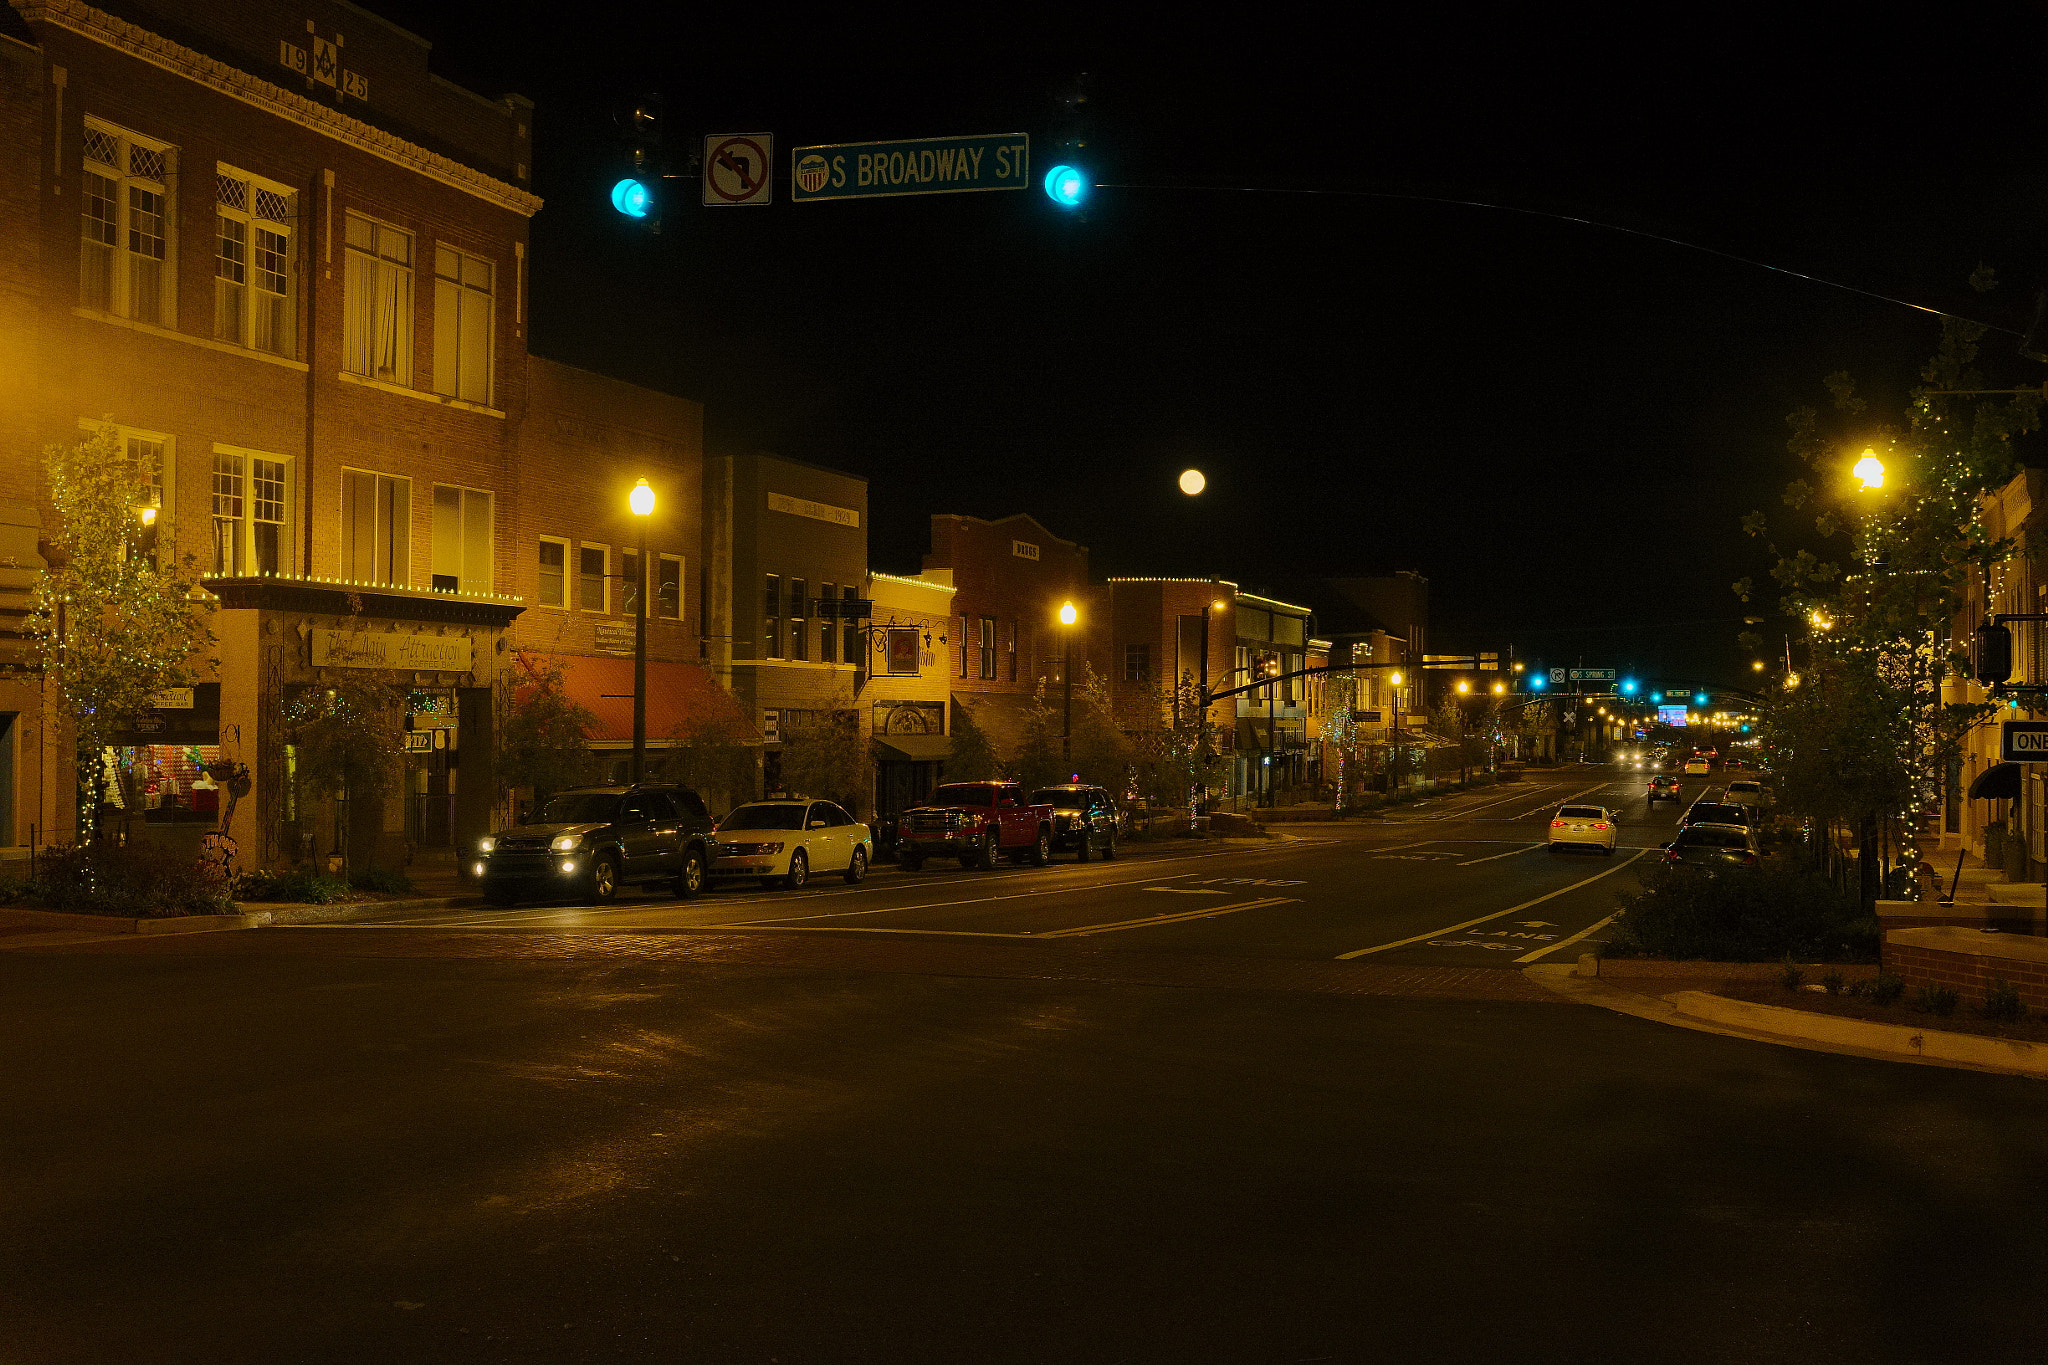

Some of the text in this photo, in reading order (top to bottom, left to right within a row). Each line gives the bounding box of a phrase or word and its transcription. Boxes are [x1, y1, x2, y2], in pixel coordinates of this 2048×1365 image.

[285, 43, 366, 97] 19 25
[832, 145, 1025, 188] S BROADWAY ST
[399, 636, 460, 660] Attraction
[408, 660, 439, 668] COFFEE
[2017, 734, 2048, 749] ONE
[1466, 928, 1560, 941] LANE
